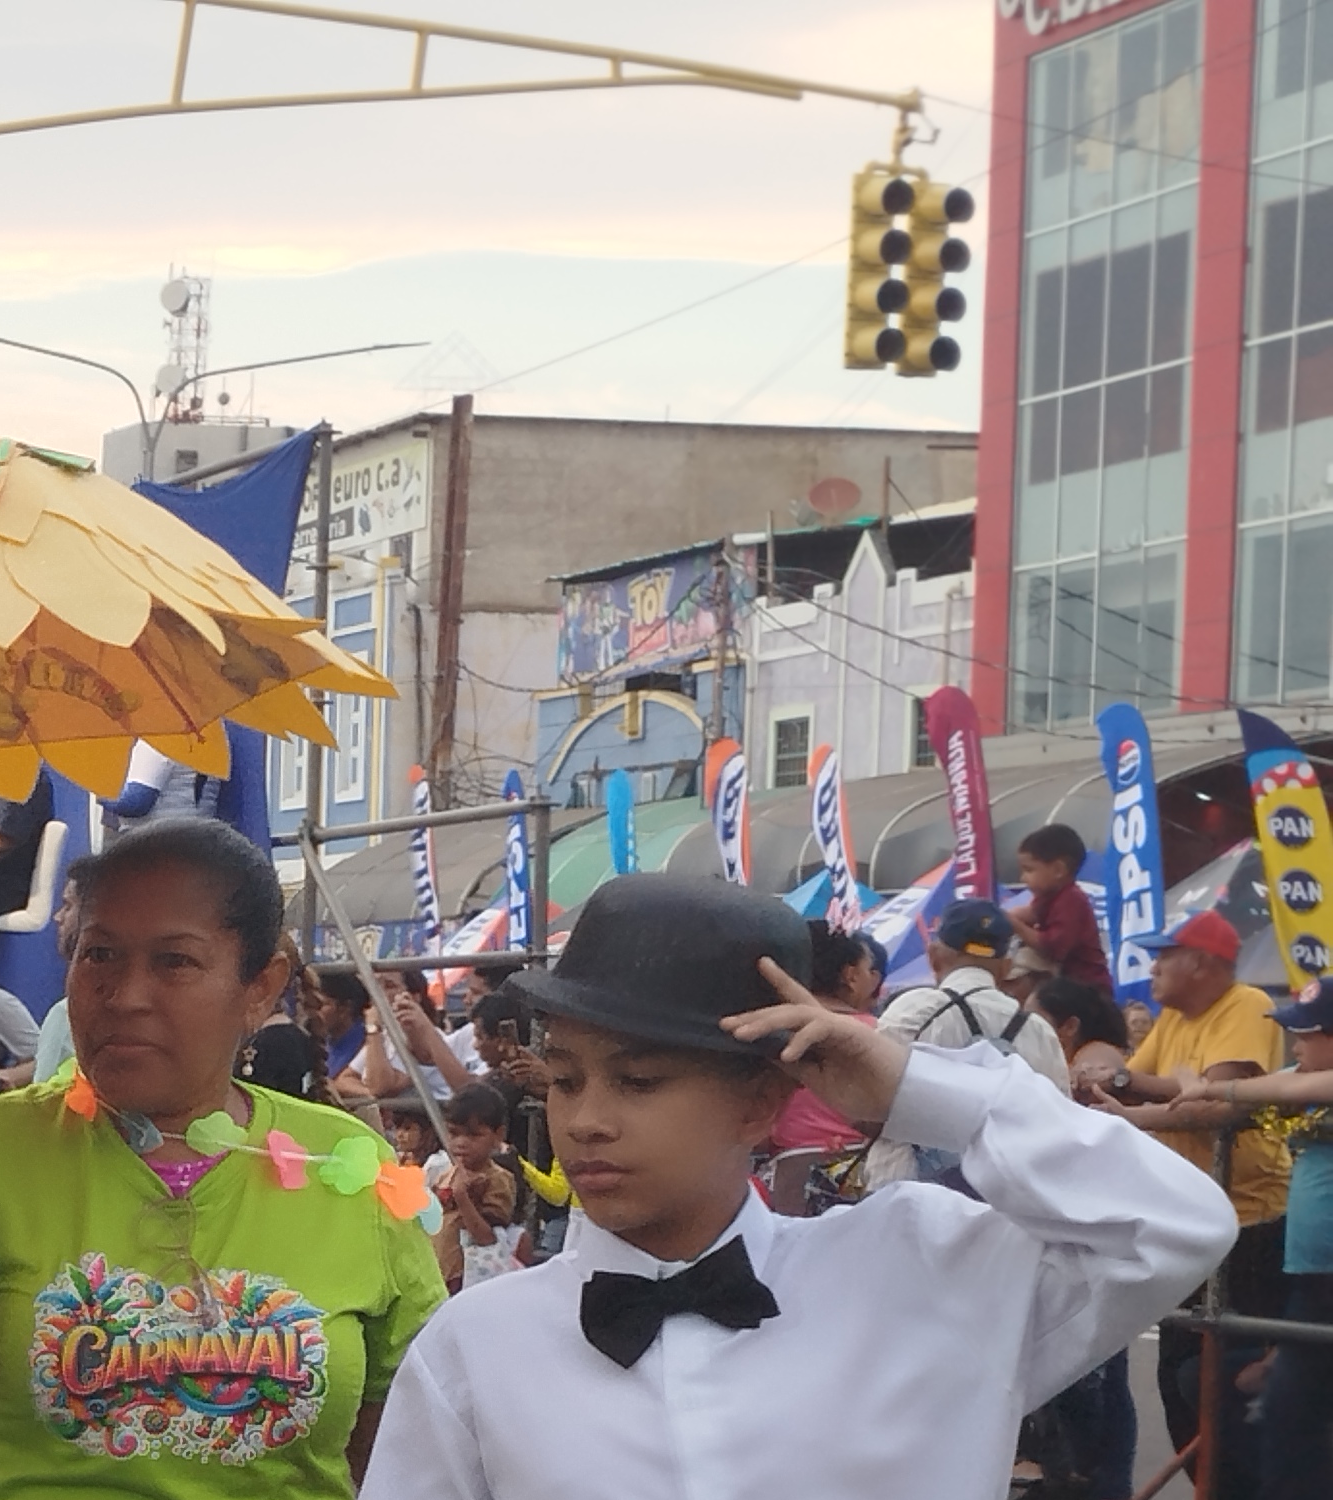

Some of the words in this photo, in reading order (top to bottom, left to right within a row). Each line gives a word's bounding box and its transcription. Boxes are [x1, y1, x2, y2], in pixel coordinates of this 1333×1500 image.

[1268, 816, 1315, 838] PAN
[1112, 784, 1156, 986] PEPSI
[1279, 880, 1323, 902] PAN
[61, 1324, 309, 1396] CARNAVAL
